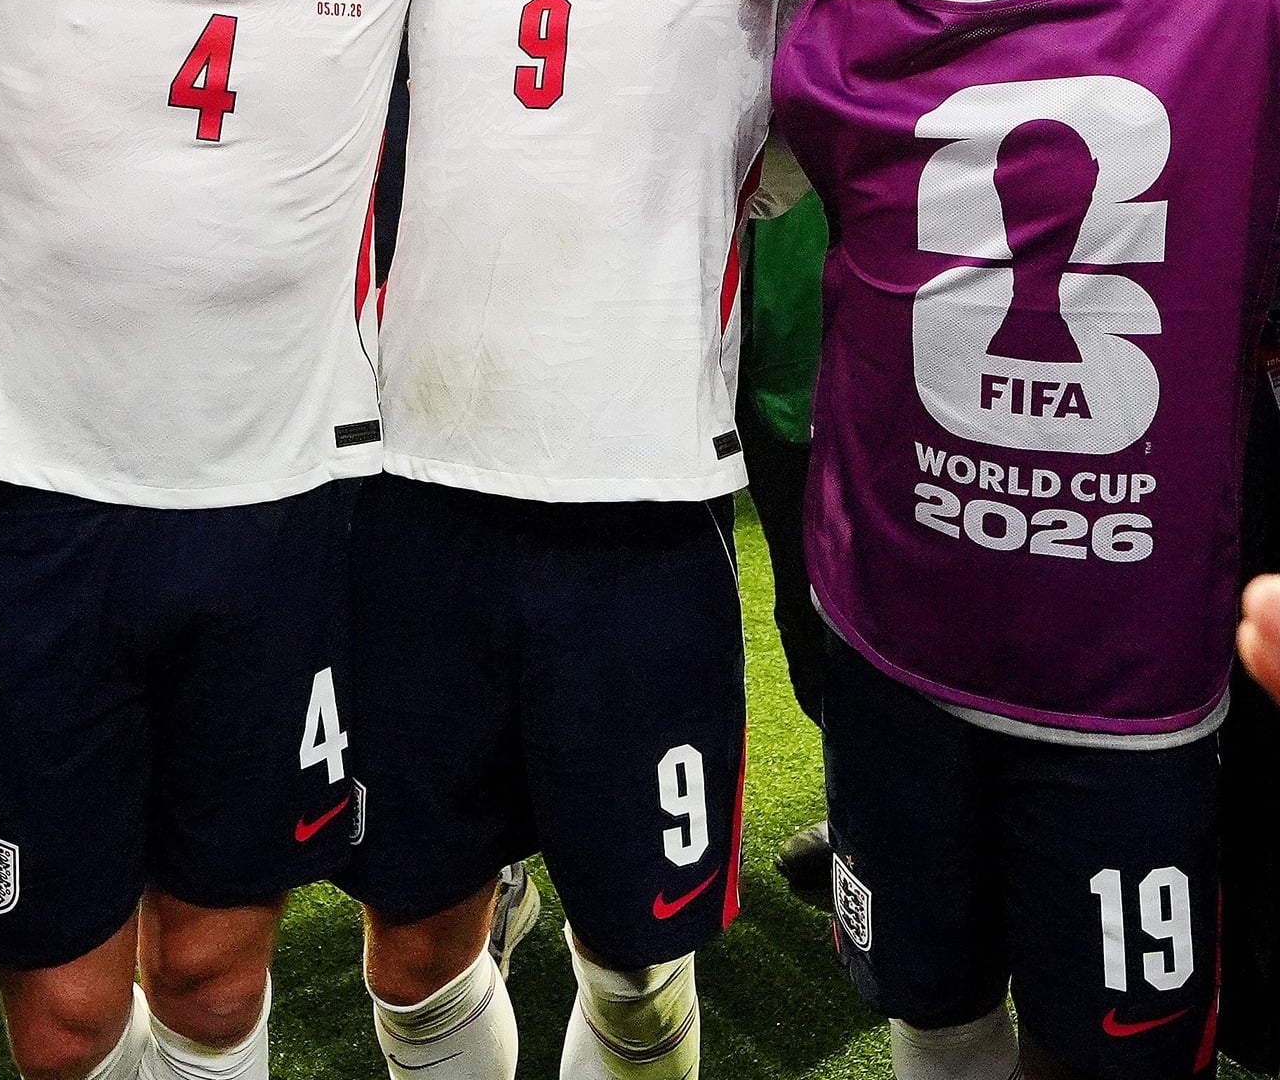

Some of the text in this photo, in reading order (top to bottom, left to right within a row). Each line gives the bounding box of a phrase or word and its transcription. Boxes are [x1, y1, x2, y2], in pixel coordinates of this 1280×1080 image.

[317, 1, 362, 18] 05.07.26
[167, 13, 238, 143] 4
[979, 373, 1093, 420] FIFA
[913, 482, 1154, 563] 2026
[914, 441, 1157, 504] WORLD CUP
[299, 666, 349, 785] 4
[657, 743, 709, 867] 9
[1090, 865, 1195, 993] 19
